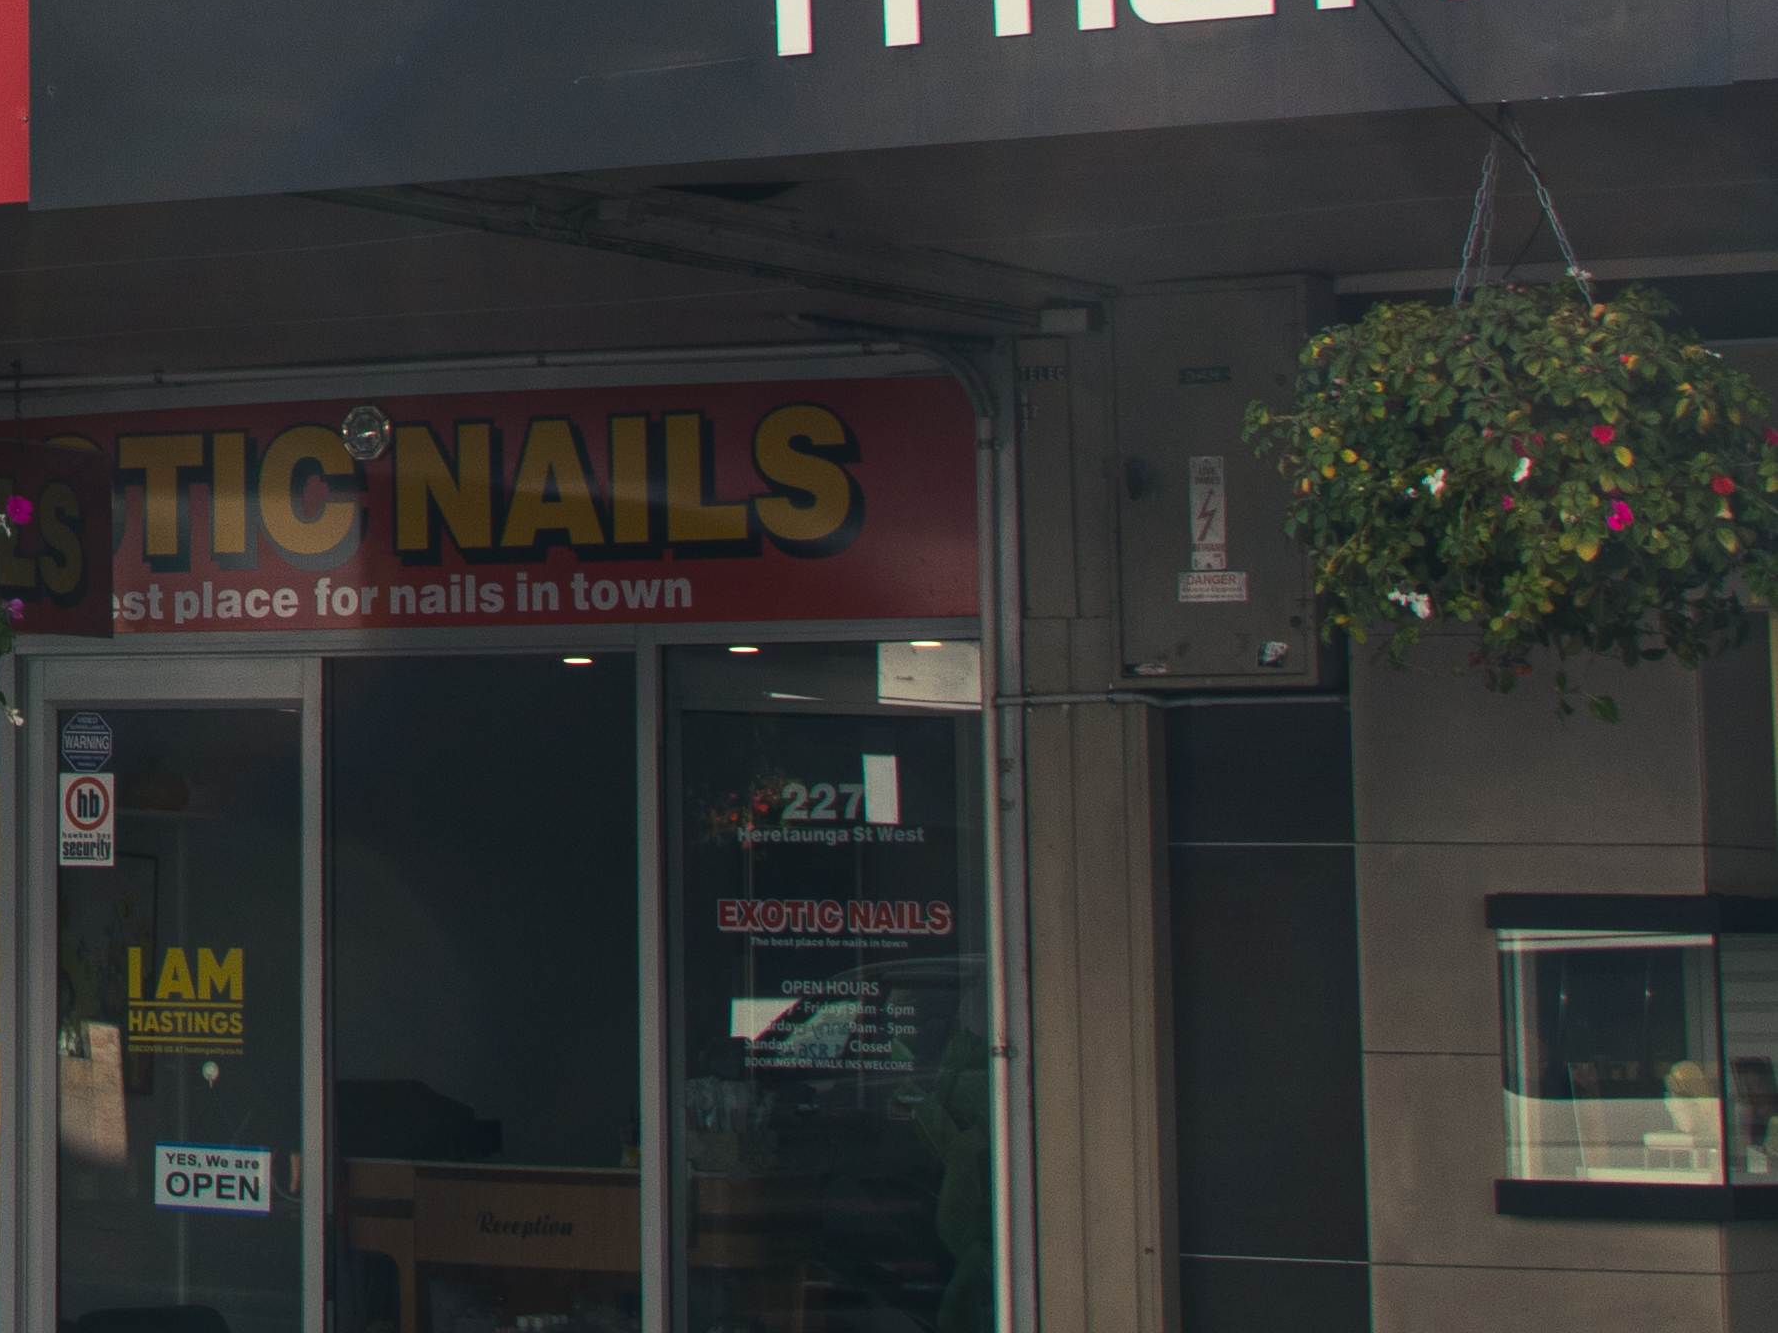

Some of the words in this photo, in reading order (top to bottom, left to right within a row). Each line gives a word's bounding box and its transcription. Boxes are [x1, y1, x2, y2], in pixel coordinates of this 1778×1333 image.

[117, 423, 366, 573] TIC
[392, 402, 864, 567] NAILS
[1187, 575, 1236, 585] DANGER
[173, 581, 298, 622] place
[314, 575, 377, 615] for
[389, 573, 500, 614] nails
[516, 572, 559, 611] in
[571, 573, 691, 610] town
[64, 735, 109, 750] WARNING
[77, 788, 99, 818] hb
[782, 782, 865, 820] 227
[738, 826, 849, 845] Heretaunga
[853, 826, 872, 843] St
[877, 826, 924, 842] West
[63, 840, 111, 860] security
[718, 900, 844, 933] EXOTIC
[848, 900, 952, 935] NAILS
[750, 937, 769, 947] The
[771, 937, 793, 947] best
[795, 938, 823, 949] place
[826, 937, 840, 947] for
[842, 937, 868, 948] nails
[882, 939, 908, 948] town
[128, 947, 142, 999] I
[155, 947, 244, 1000] AM
[781, 980, 822, 995] OPEN
[826, 981, 880, 996] HOURS
[804, 1001, 847, 1016] Friday:
[849, 1002, 876, 1015] 9am
[887, 1004, 915, 1018] 6pm
[128, 1010, 243, 1035] HASTINGS
[849, 1022, 877, 1034] 9am
[887, 1023, 916, 1036] 5pm
[849, 1040, 892, 1054] Closed
[745, 1057, 797, 1069] BOOKINGS
[799, 1057, 813, 1069] OR
[815, 1058, 843, 1070] WALK
[845, 1059, 861, 1070] INS
[862, 1059, 915, 1072] WELCOME
[166, 1153, 201, 1169] YES,
[206, 1154, 229, 1168] We
[234, 1159, 260, 1171] are
[166, 1171, 260, 1202] OPEN
[475, 1210, 574, 1239] Reception
